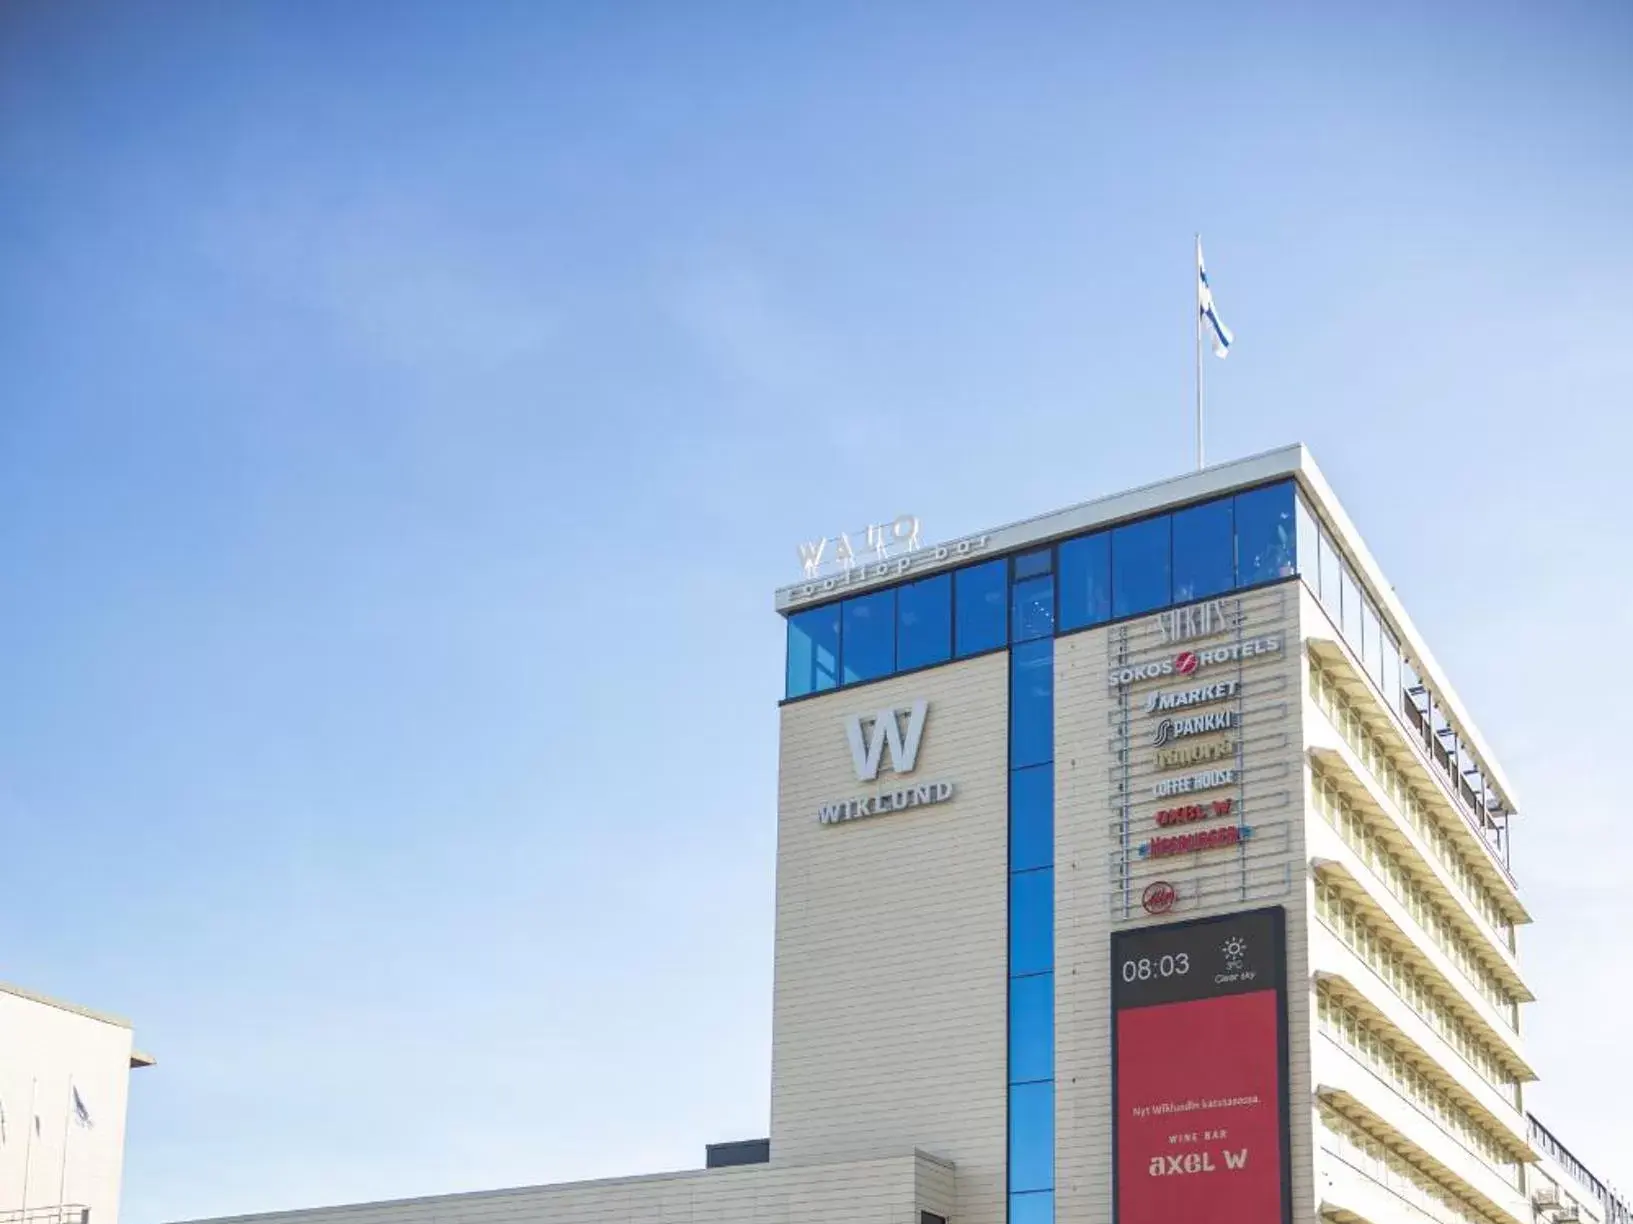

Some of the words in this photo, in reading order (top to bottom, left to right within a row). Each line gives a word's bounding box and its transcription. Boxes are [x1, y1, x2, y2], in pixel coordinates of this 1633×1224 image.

[1108, 660, 1172, 696] SOKOS
[1200, 637, 1279, 666] HOTELS
[1159, 680, 1238, 711] MARKET
[1173, 709, 1231, 737] PANKKI
[845, 698, 928, 782] W
[1153, 777, 1194, 798] COFFEE
[1194, 768, 1233, 789] HOUSE
[818, 782, 953, 824] WIKLUND
[1122, 952, 1190, 983] 08:03
[1168, 1133, 1199, 1144] WINE
[1204, 1129, 1228, 1141] BAR
